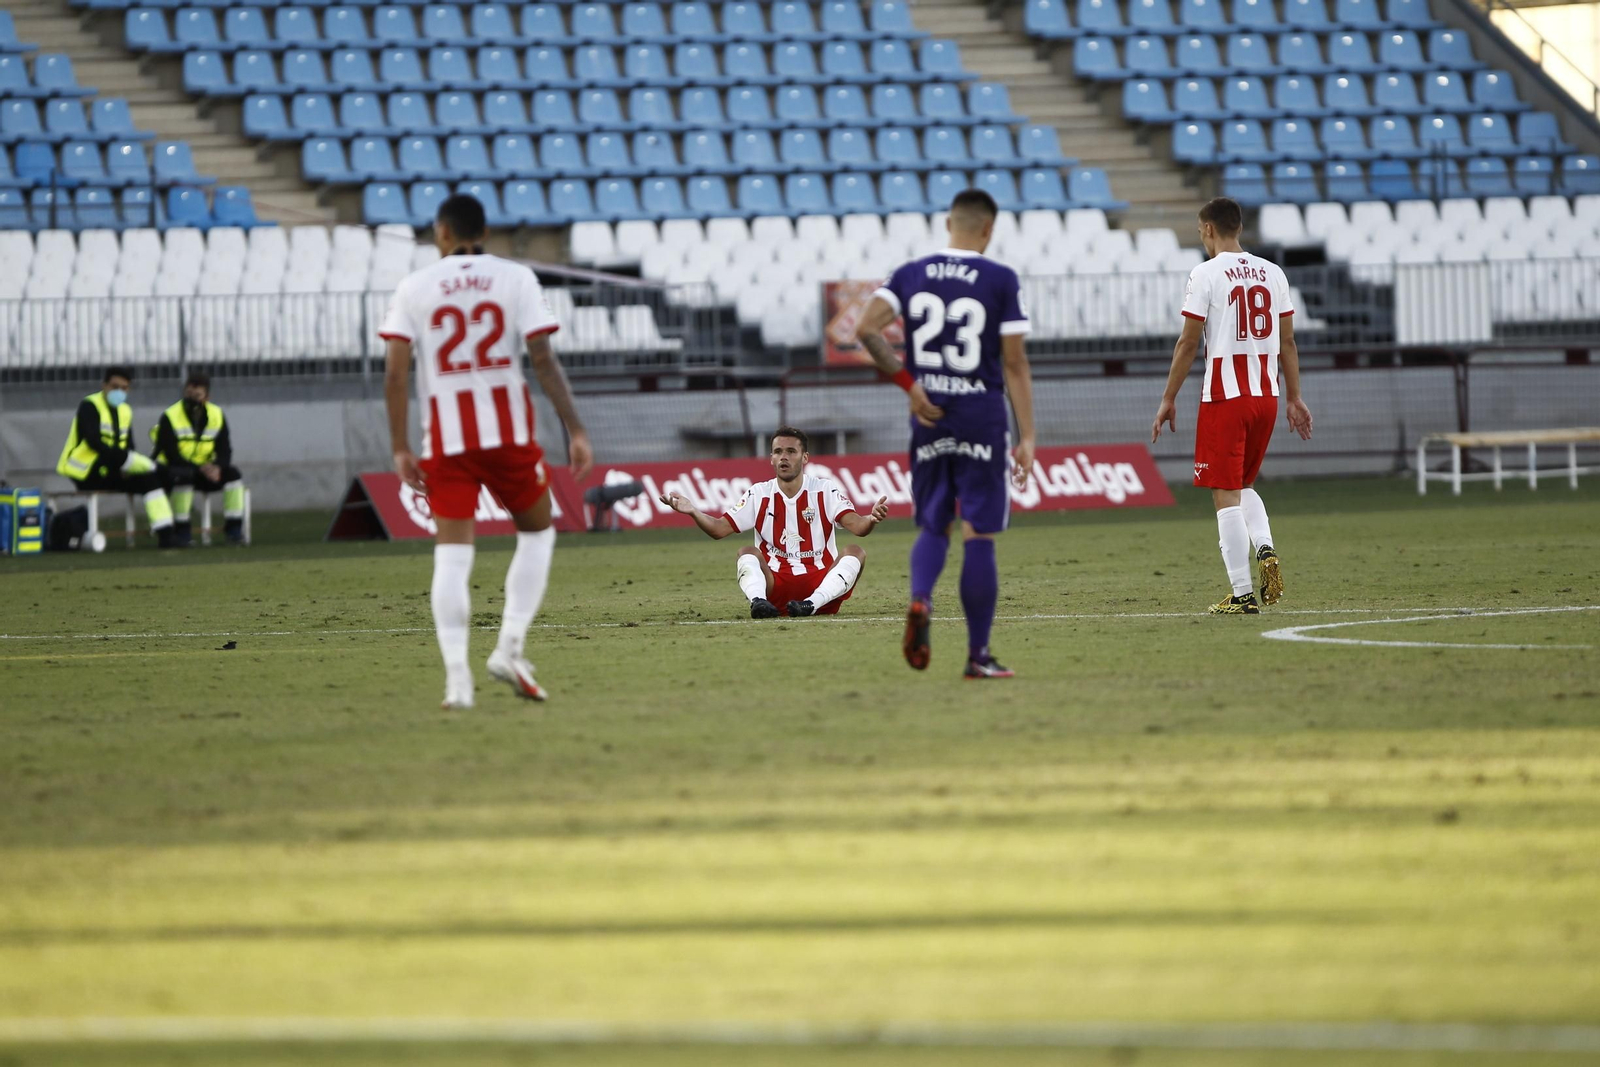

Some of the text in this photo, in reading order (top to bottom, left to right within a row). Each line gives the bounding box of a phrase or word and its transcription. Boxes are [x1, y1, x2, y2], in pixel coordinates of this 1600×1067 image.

[440, 276, 493, 295] SAMU
[1224, 266, 1267, 282] MARAŠ
[431, 301, 511, 375] 22
[908, 292, 987, 372] 23
[1228, 285, 1273, 341] 18
[916, 437, 992, 462] NISSAN
[1033, 453, 1145, 503] LaLiga
